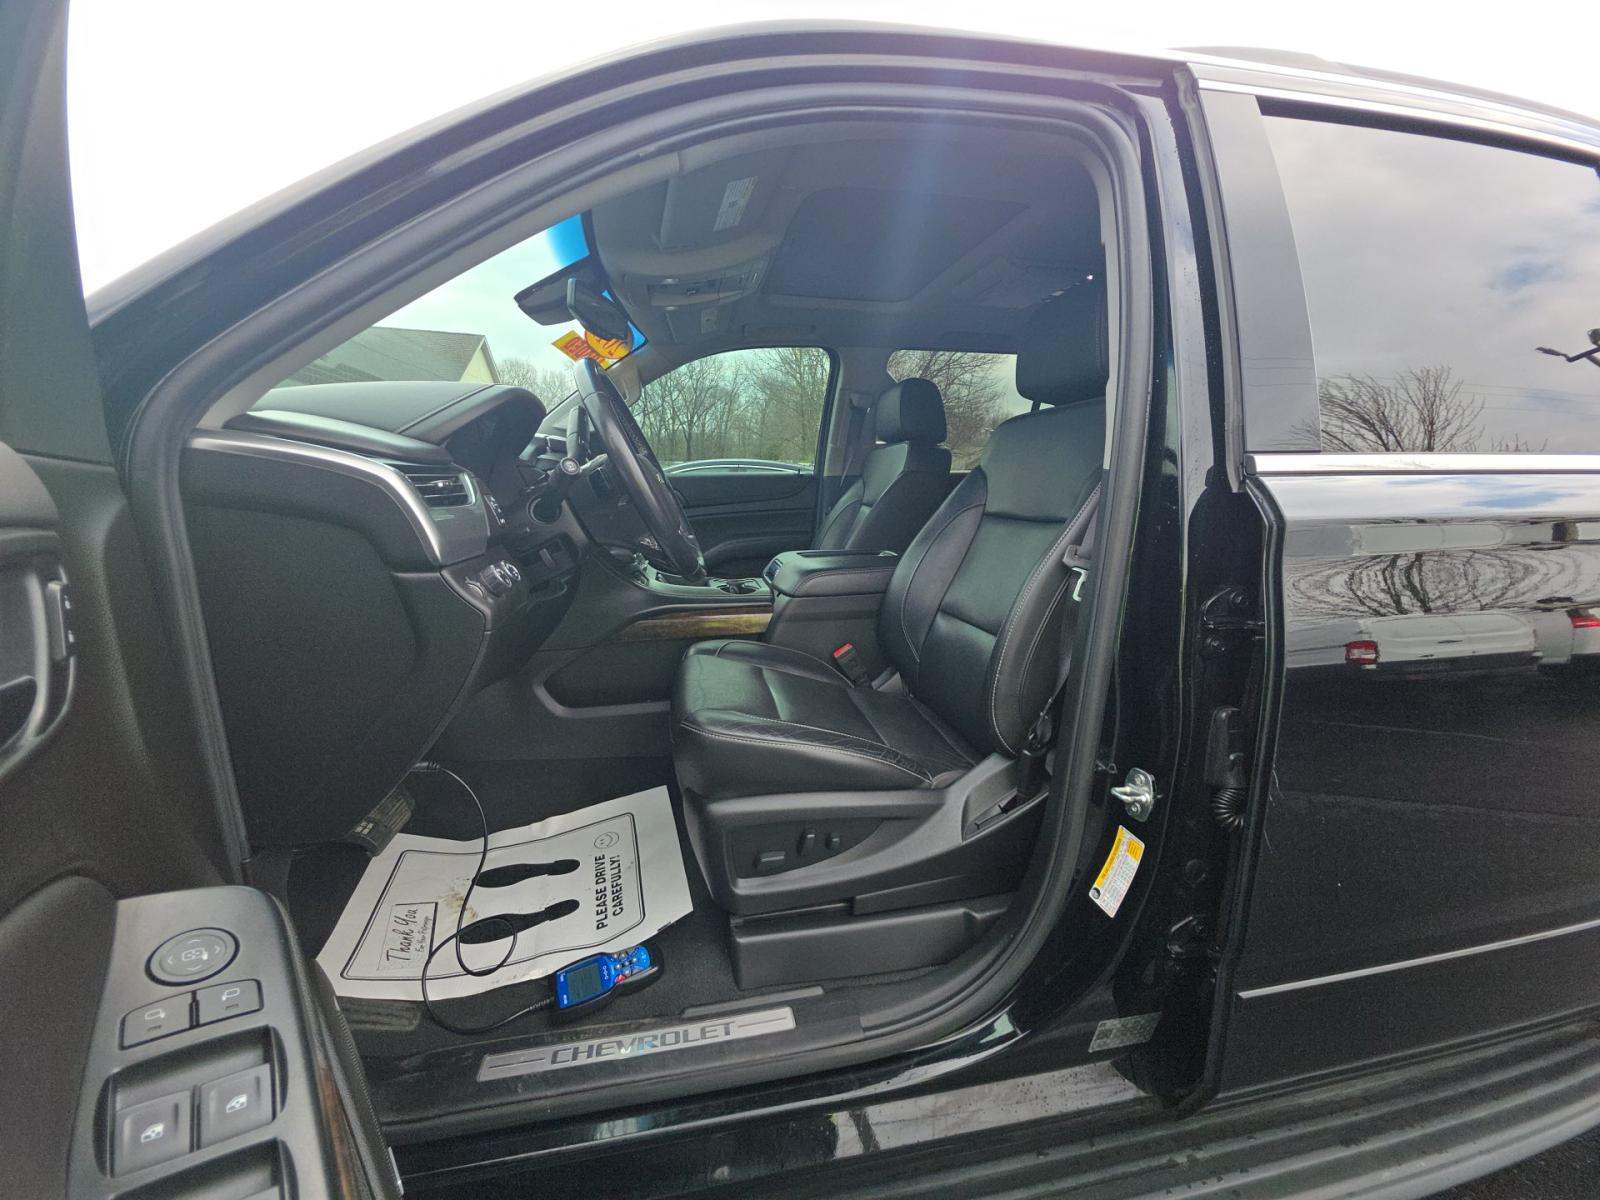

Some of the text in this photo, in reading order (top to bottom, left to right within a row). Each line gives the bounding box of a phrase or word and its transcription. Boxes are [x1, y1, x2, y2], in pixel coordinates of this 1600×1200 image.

[595, 854, 608, 930] PLEASE DRIVE
[609, 854, 623, 916] CAREFULLY!
[386, 908, 418, 961] Thank You
[551, 1021, 735, 1065] CHEVROLET
